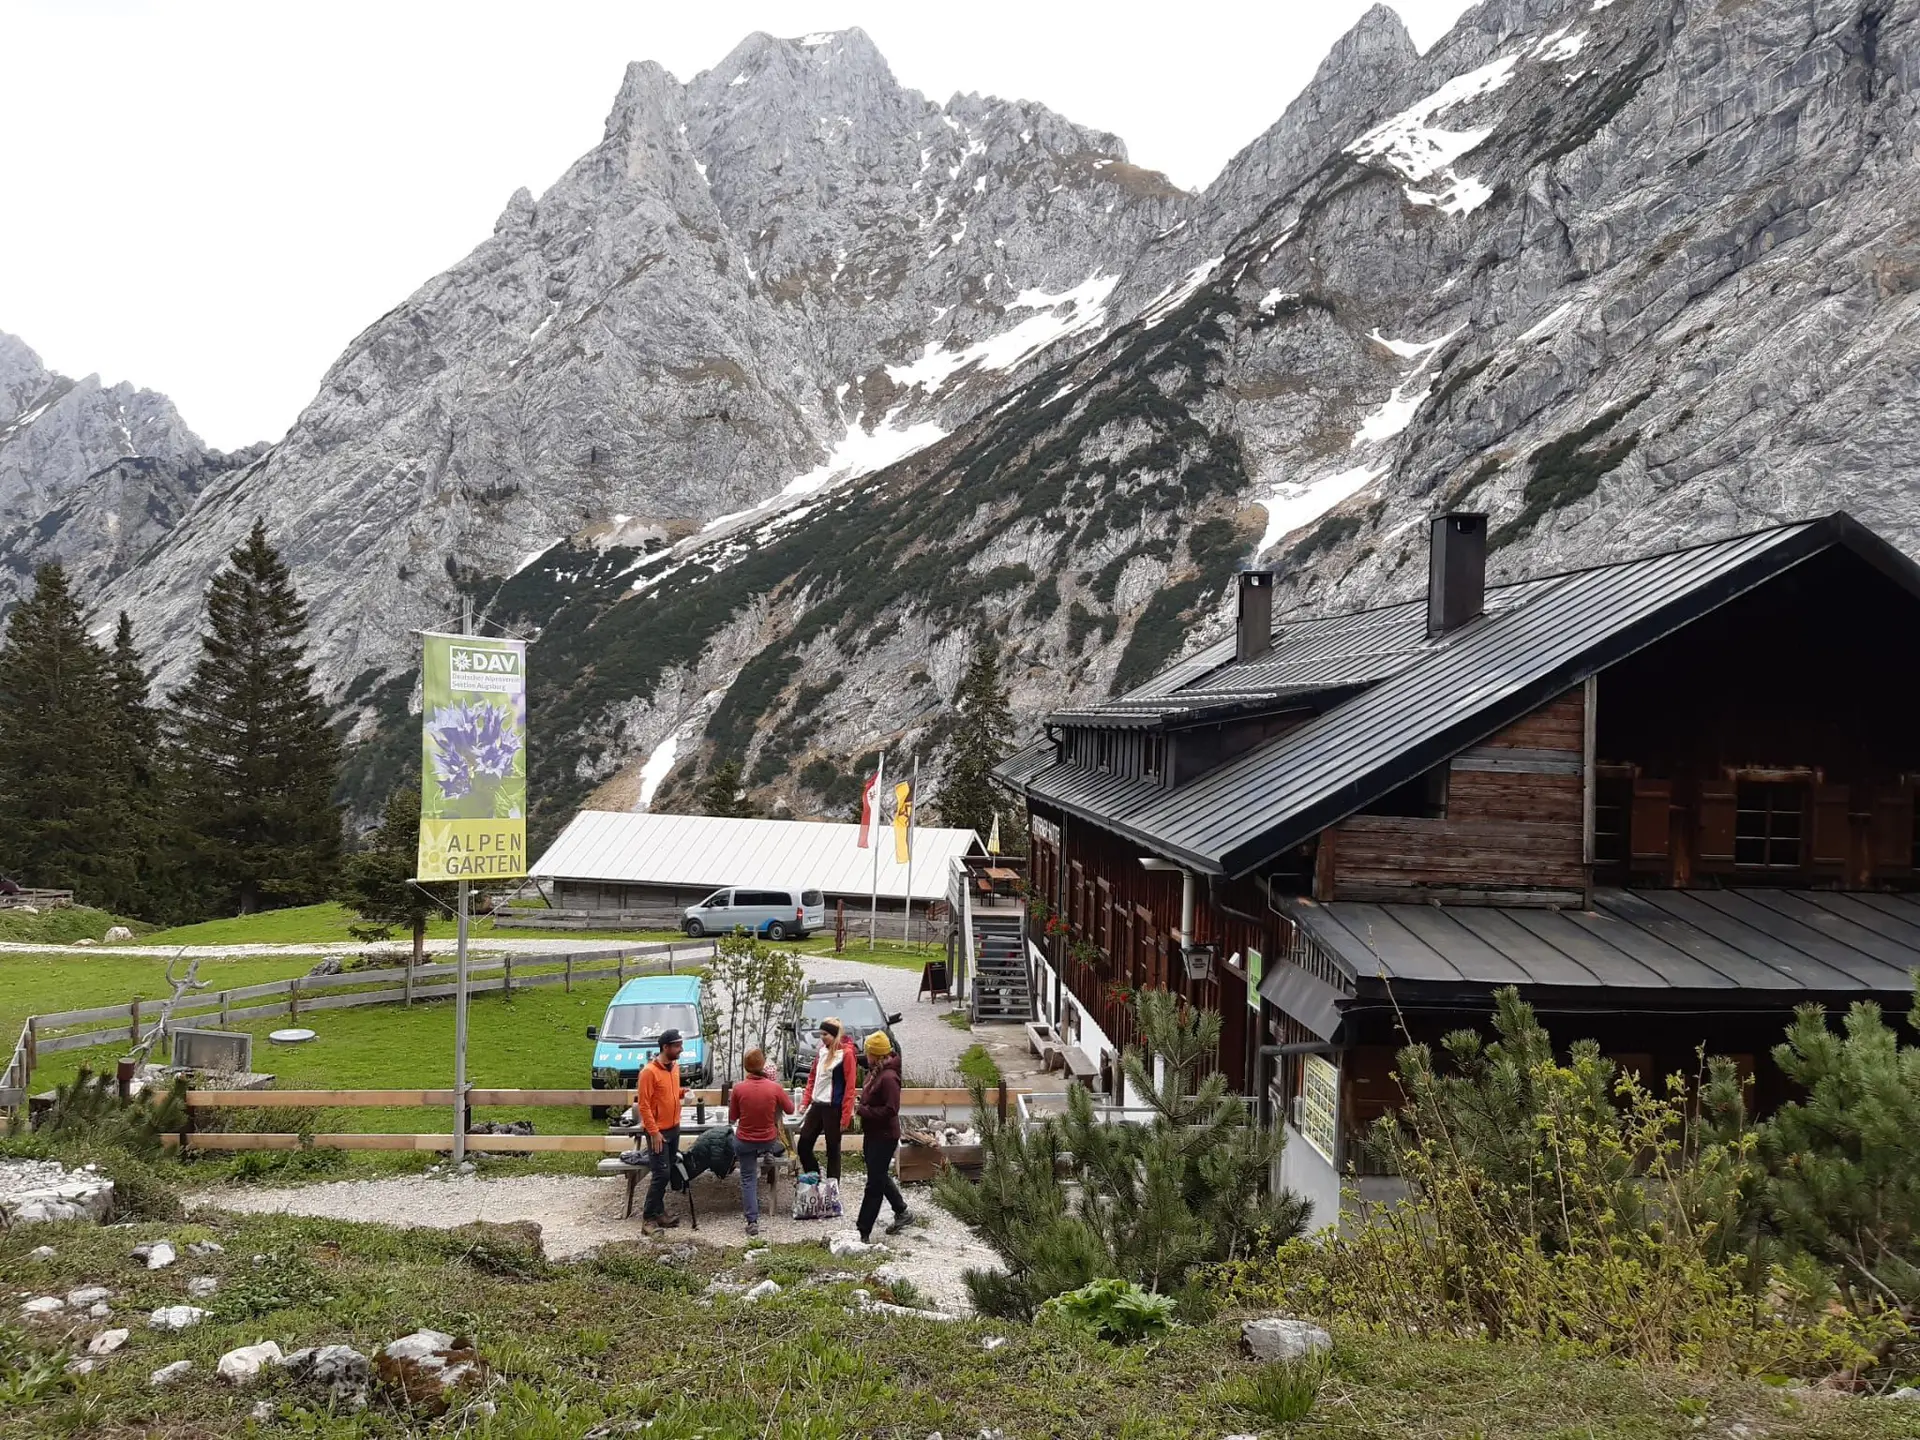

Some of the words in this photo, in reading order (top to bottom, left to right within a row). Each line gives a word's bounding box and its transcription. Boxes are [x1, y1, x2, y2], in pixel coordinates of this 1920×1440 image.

[472, 653, 516, 672] DAV
[447, 833, 521, 853] ALPEN
[446, 855, 521, 875] GARTEN
